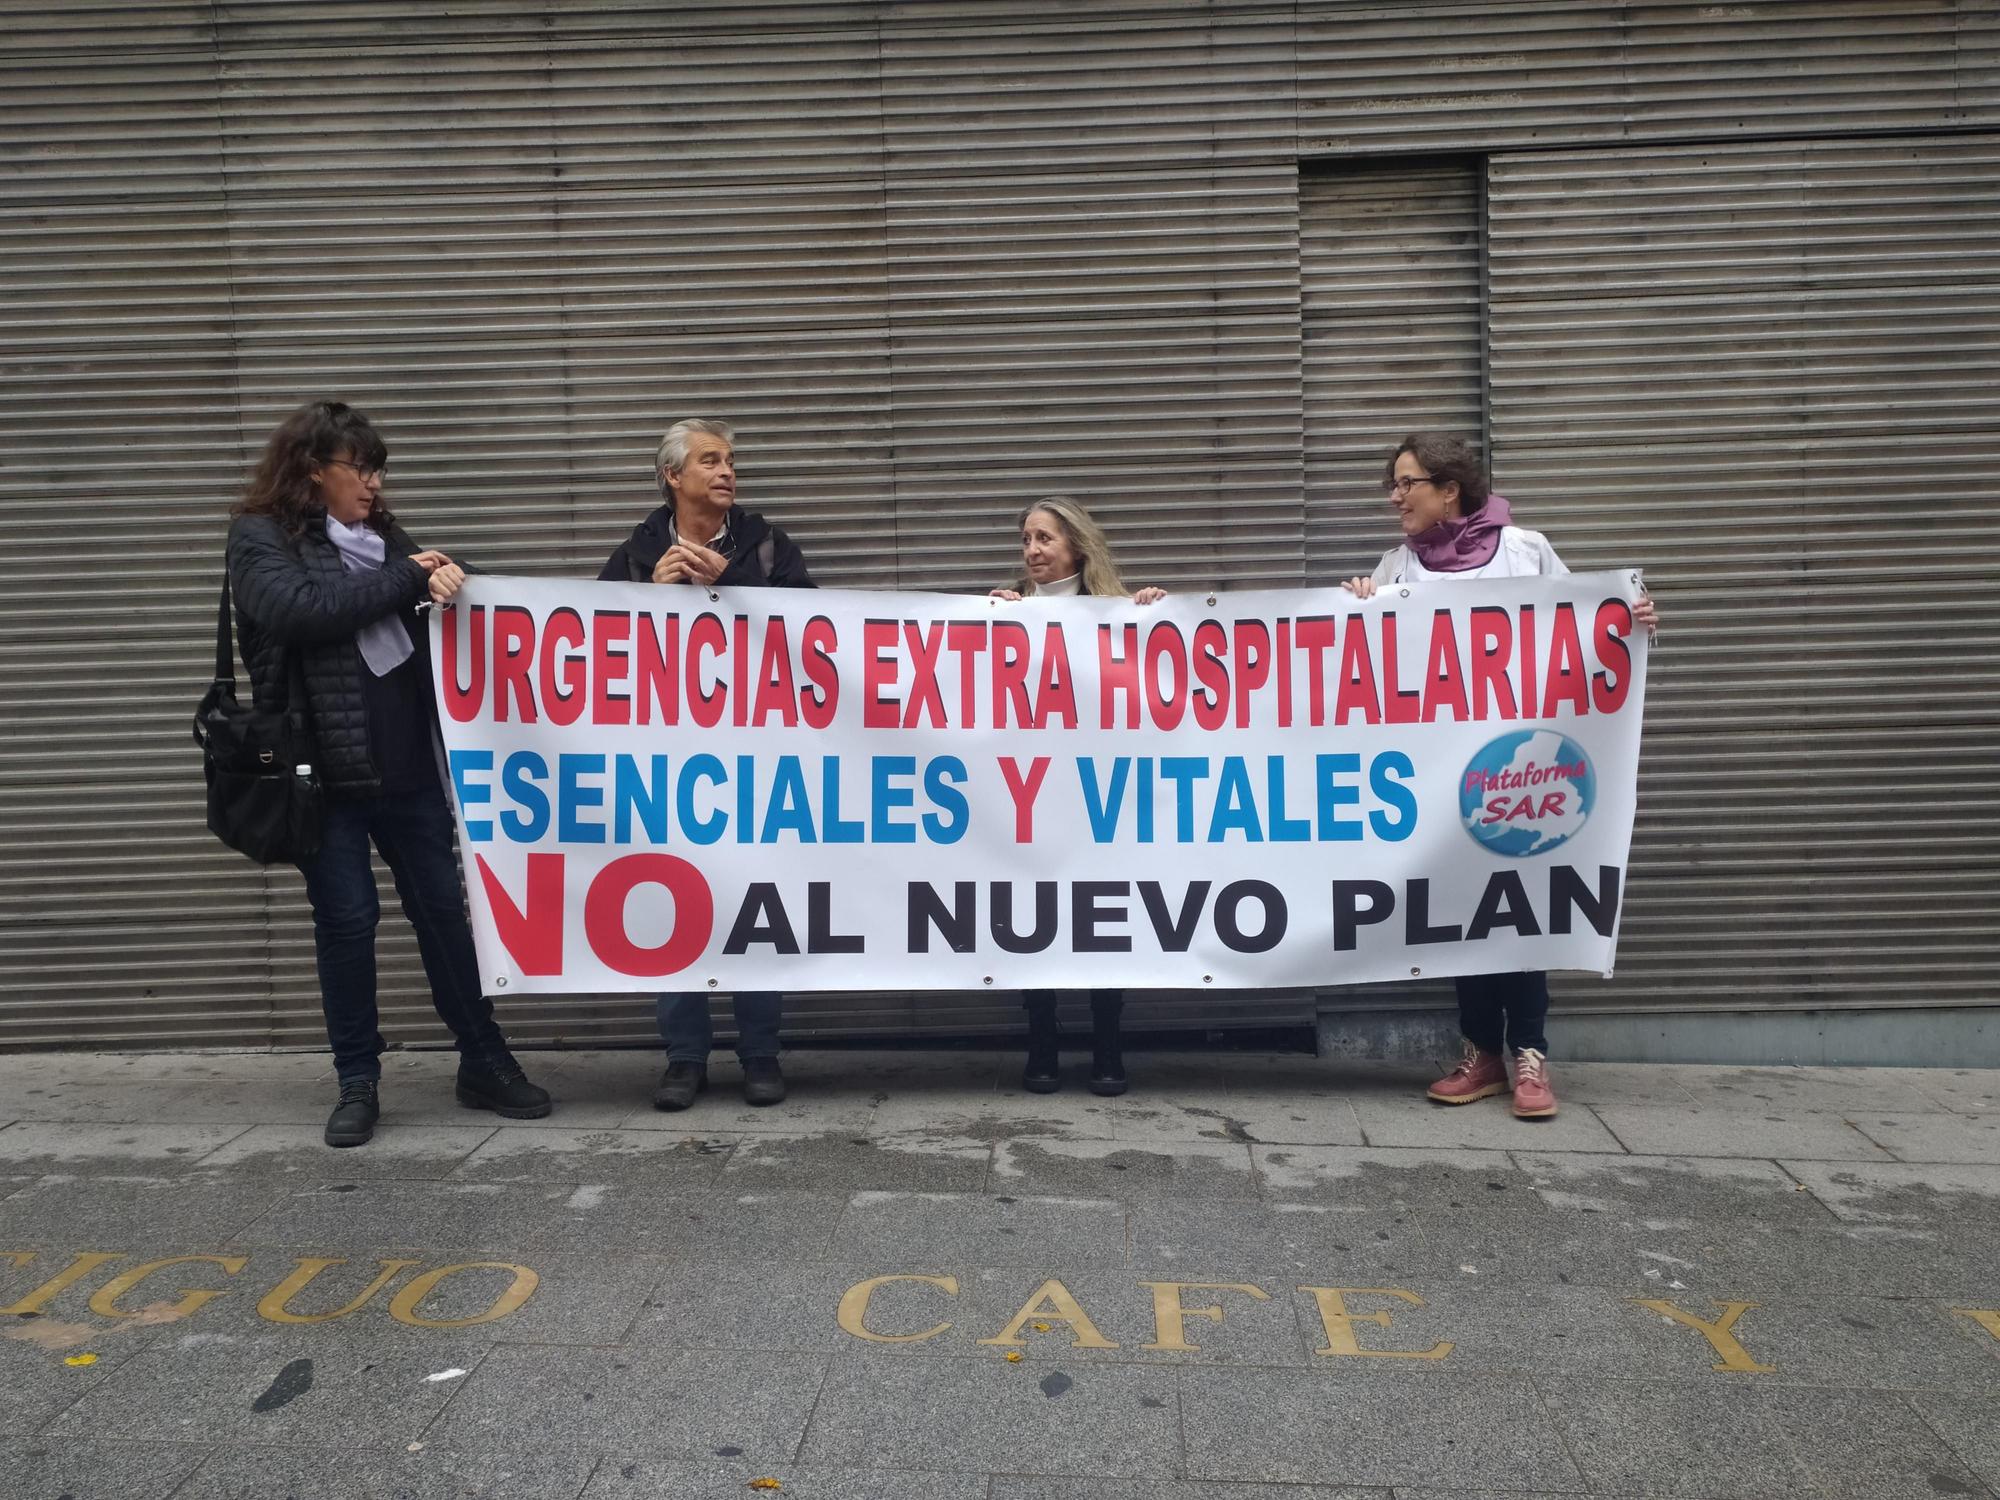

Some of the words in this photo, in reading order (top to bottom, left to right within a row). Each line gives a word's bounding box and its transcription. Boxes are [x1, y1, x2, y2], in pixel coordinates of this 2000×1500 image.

[442, 605, 839, 728] URGENCIAS
[863, 618, 1078, 730] EXTRA
[1098, 597, 1632, 732] HOSPITALARIAS
[449, 750, 970, 845] ESENCIALES
[996, 756, 1052, 844] Y
[1076, 750, 1418, 844] VITALES
[1465, 760, 1586, 794] Plataforma
[1481, 791, 1567, 824] SAR
[475, 852, 715, 978] NO
[722, 881, 865, 955] AL
[907, 879, 1289, 954] NUEVO
[1332, 865, 1621, 952] PLAN
[836, 1274, 1456, 1360] CAFE
[1621, 1297, 1778, 1374] Y
